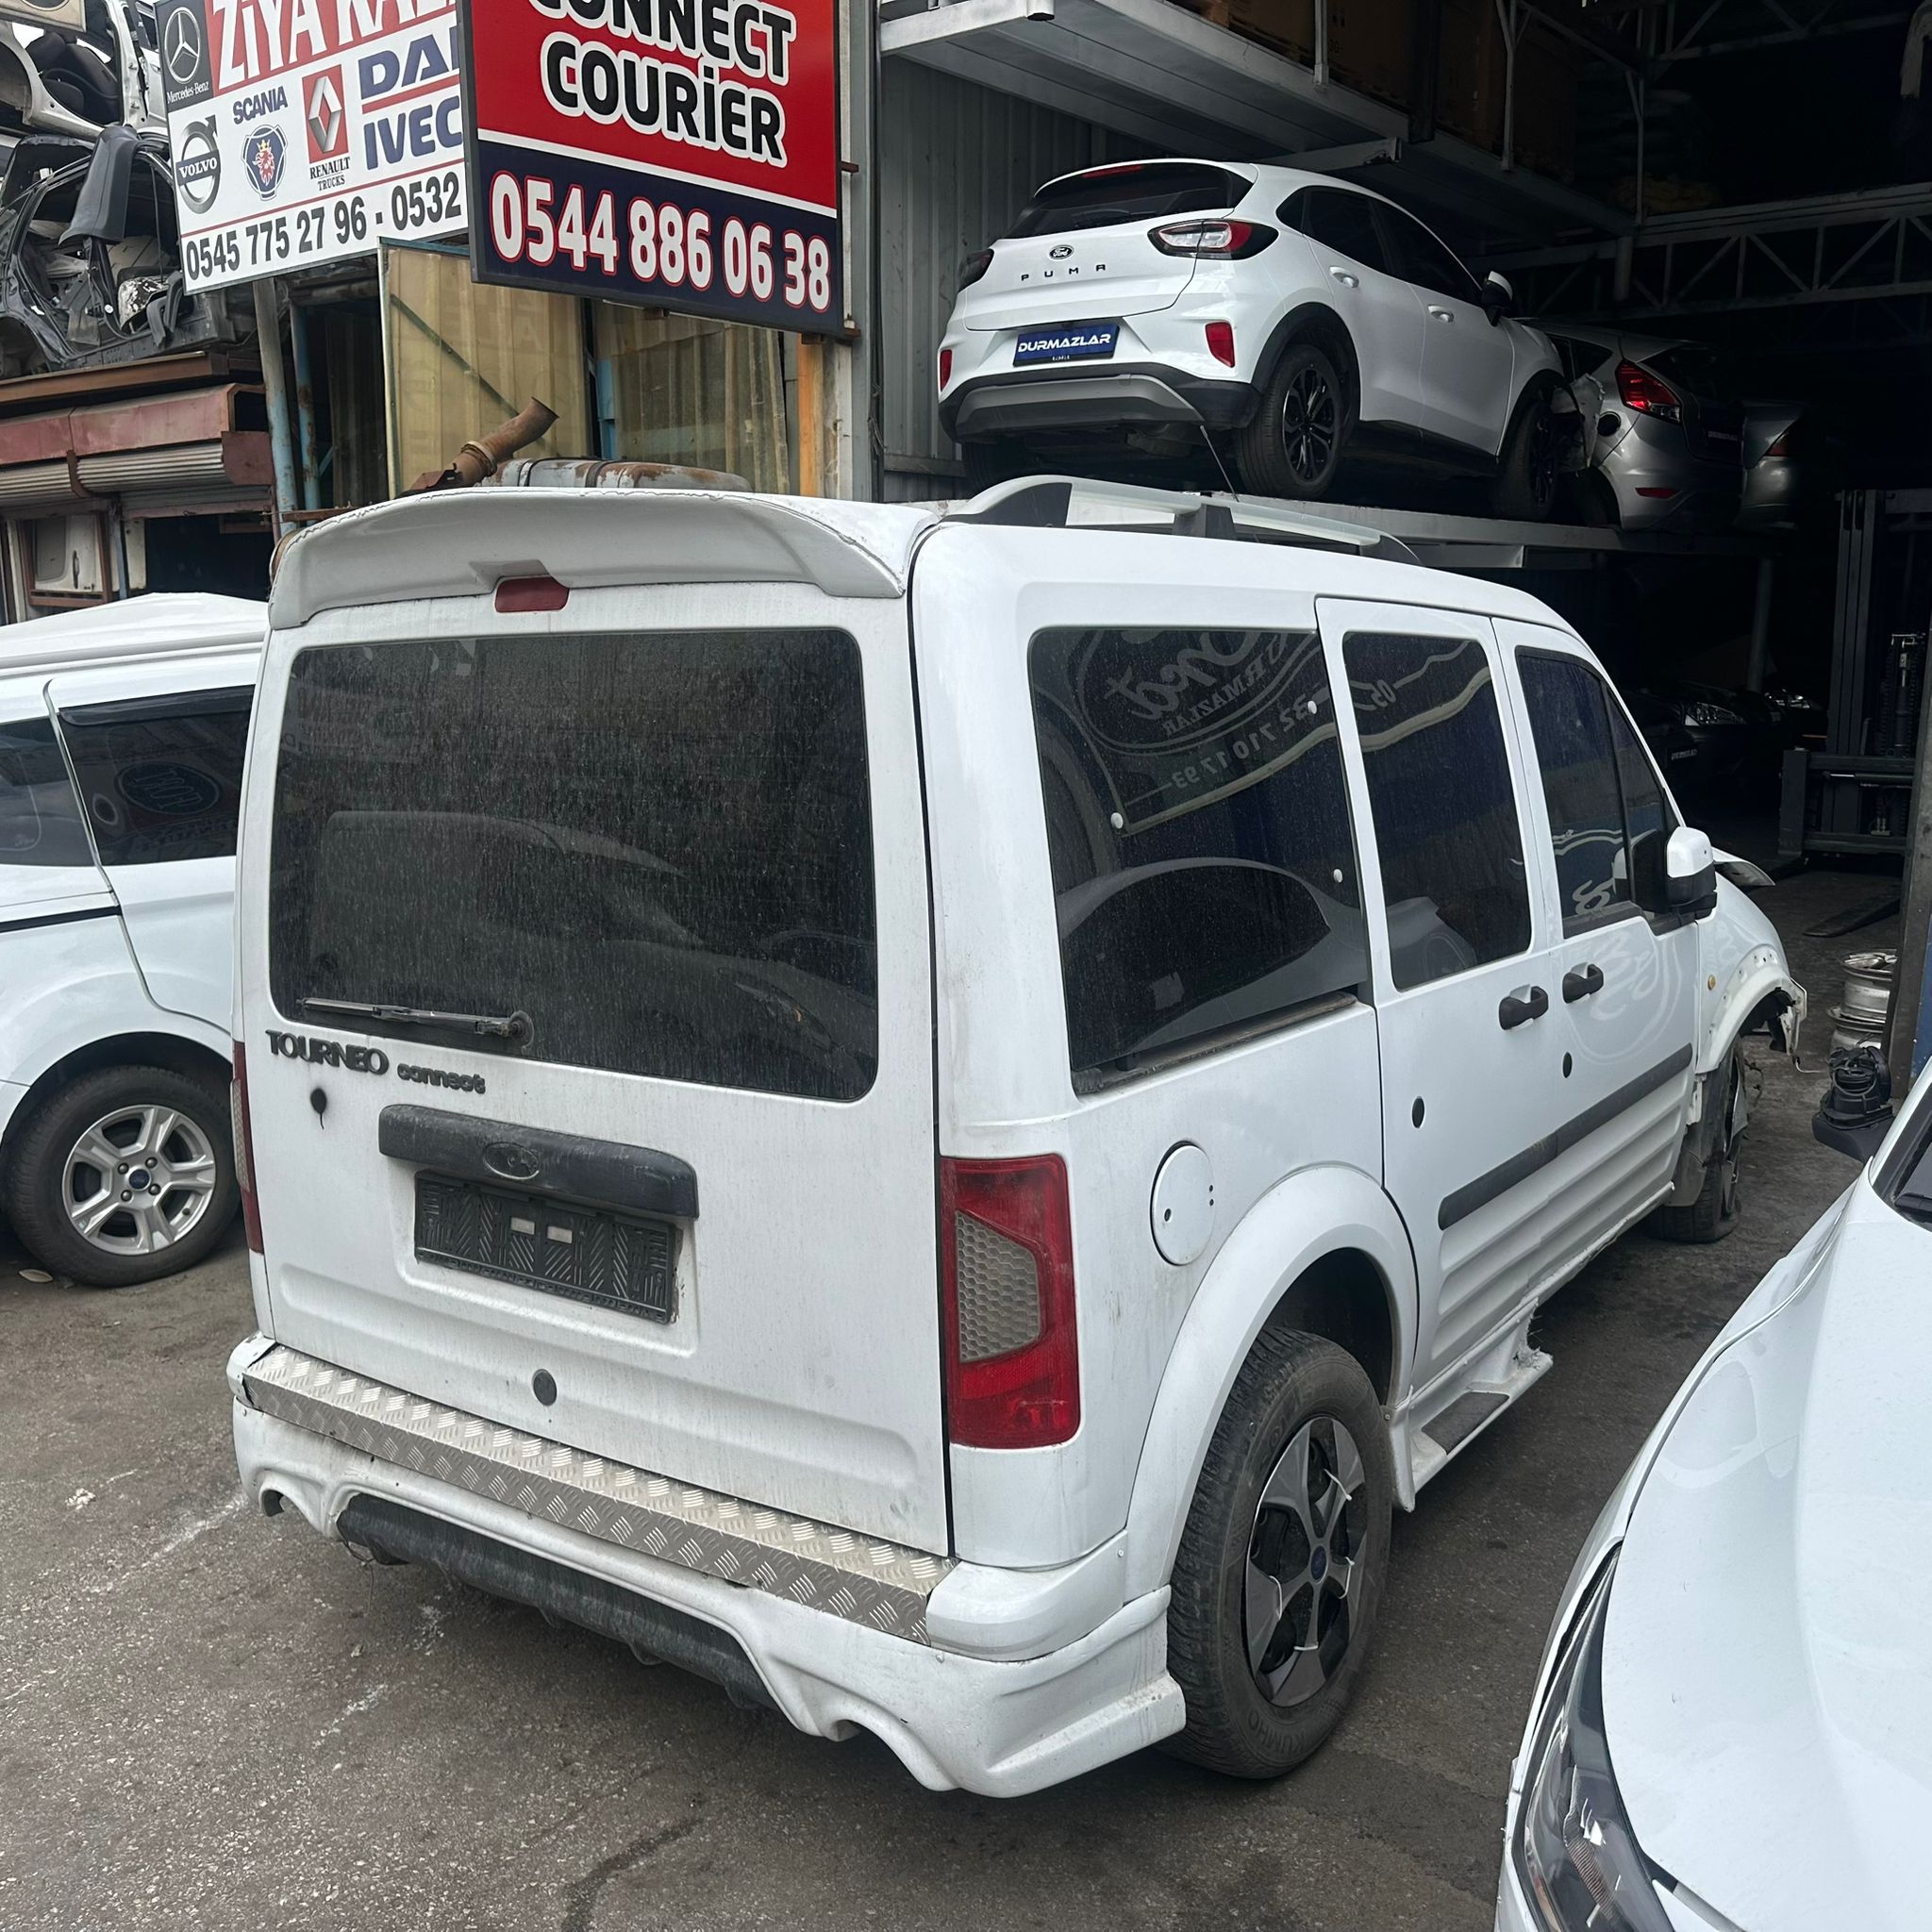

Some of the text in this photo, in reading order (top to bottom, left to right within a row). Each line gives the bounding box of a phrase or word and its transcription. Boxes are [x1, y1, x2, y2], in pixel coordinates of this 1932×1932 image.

[166, 81, 209, 104] Mercedes-Benz
[233, 86, 288, 125] SCANIA
[363, 95, 462, 171] IVEC
[179, 158, 218, 178] VOLVO
[309, 157, 350, 180] RENAULT
[318, 175, 345, 192] TRUCKS
[186, 231, 240, 281] 0545
[245, 216, 290, 265] 775
[296, 207, 325, 253] 27
[334, 195, 367, 244] 96
[391, 172, 461, 231] 0532
[491, 172, 831, 312] 0544 886 06 38
[1021, 263, 1107, 281] PUMA
[1018, 333, 1112, 353] DURMAZLAR
[265, 1028, 486, 1095] TOURNEO connect
